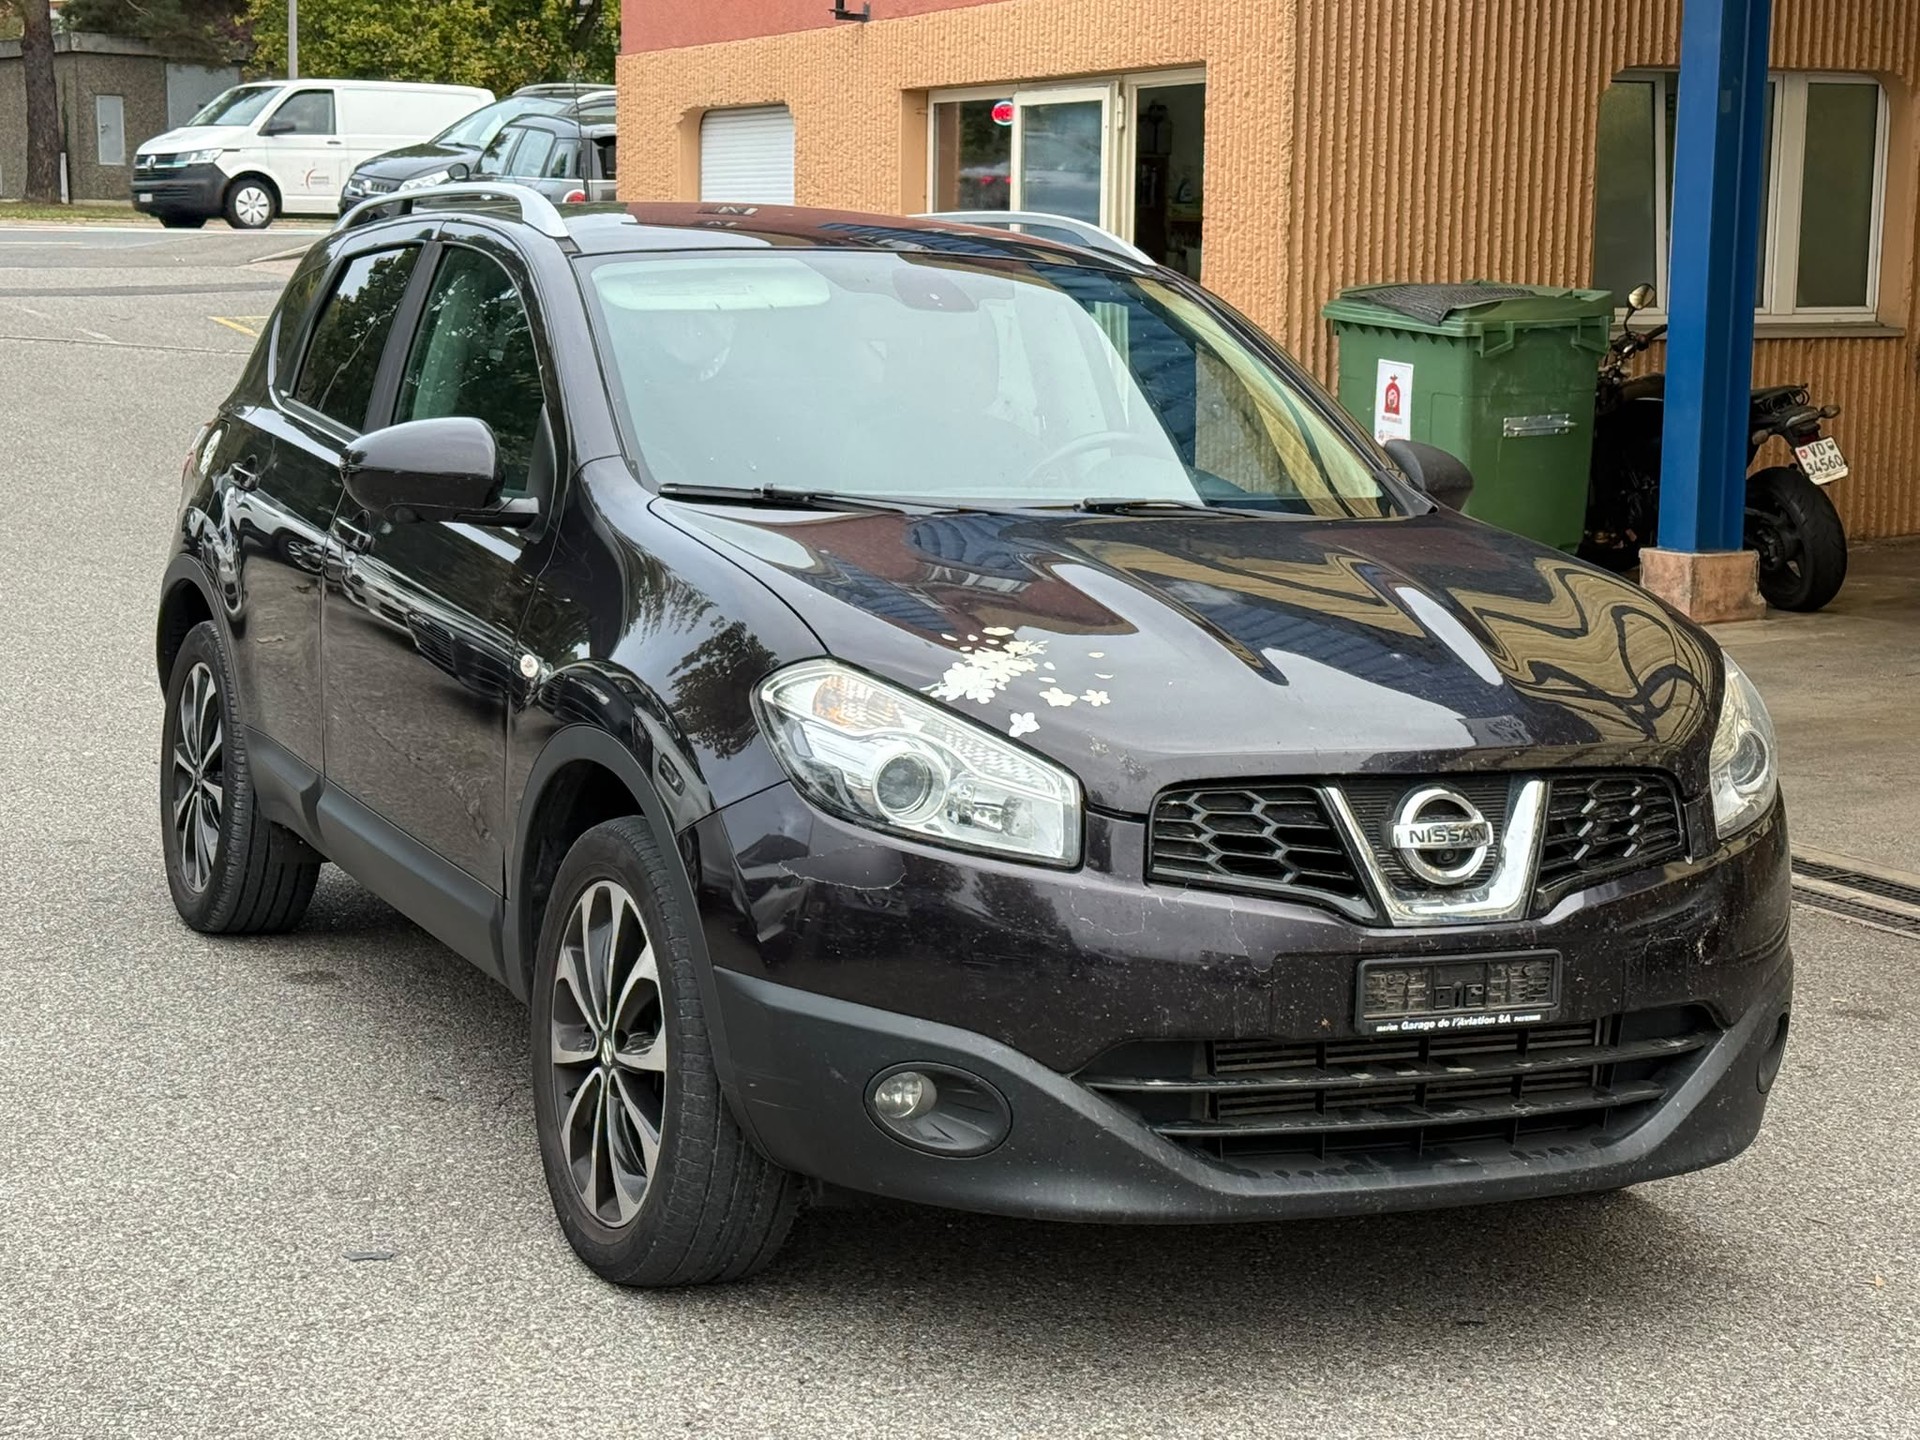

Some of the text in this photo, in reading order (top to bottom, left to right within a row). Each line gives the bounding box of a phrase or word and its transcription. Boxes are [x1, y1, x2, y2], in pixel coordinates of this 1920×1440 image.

[1807, 442, 1826, 458] VD
[1805, 454, 1844, 475] 34560
[1408, 827, 1487, 843] NISSAN
[1401, 1020, 1436, 1031] Garage
[1437, 1017, 1450, 1028] de
[1498, 1014, 1511, 1024] SA
